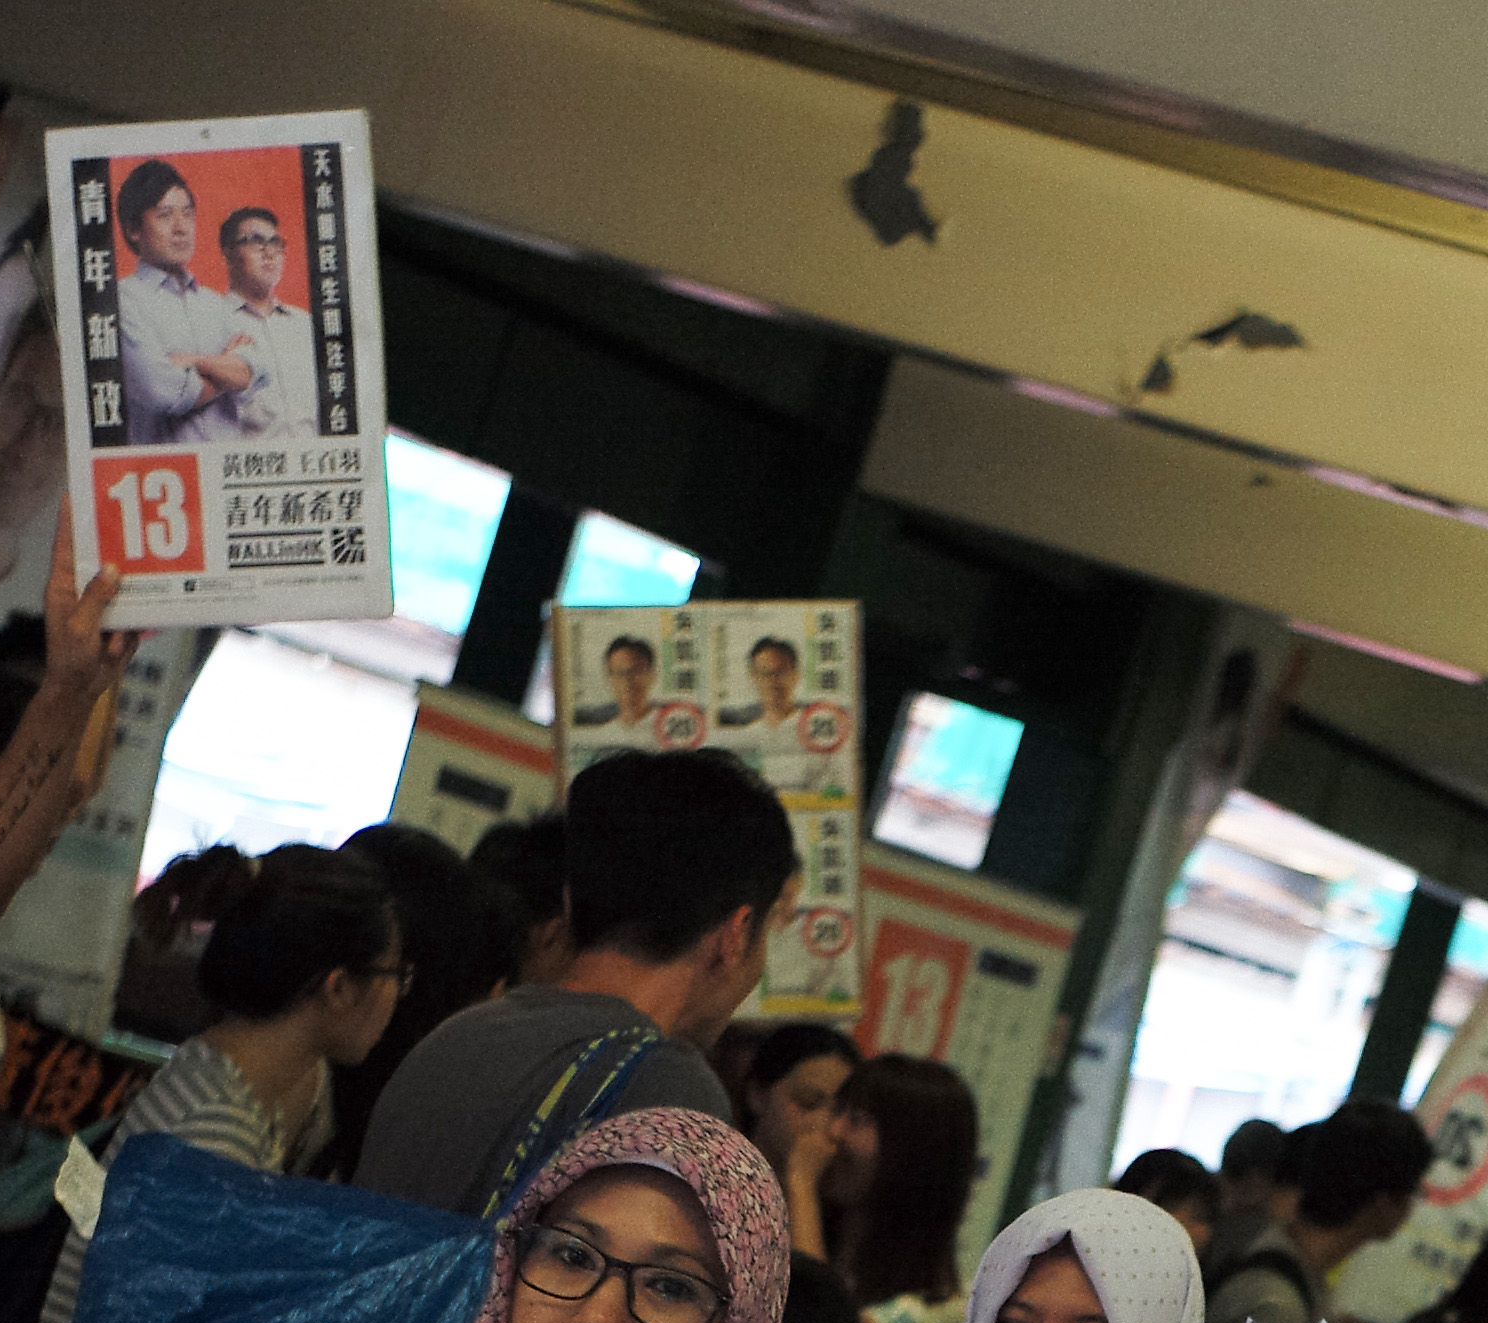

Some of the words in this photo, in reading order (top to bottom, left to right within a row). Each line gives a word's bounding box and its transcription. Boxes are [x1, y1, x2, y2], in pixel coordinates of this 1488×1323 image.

[78, 179, 125, 428] 青年新政
[107, 468, 189, 561] 13
[225, 491, 364, 528] 青年新希望
